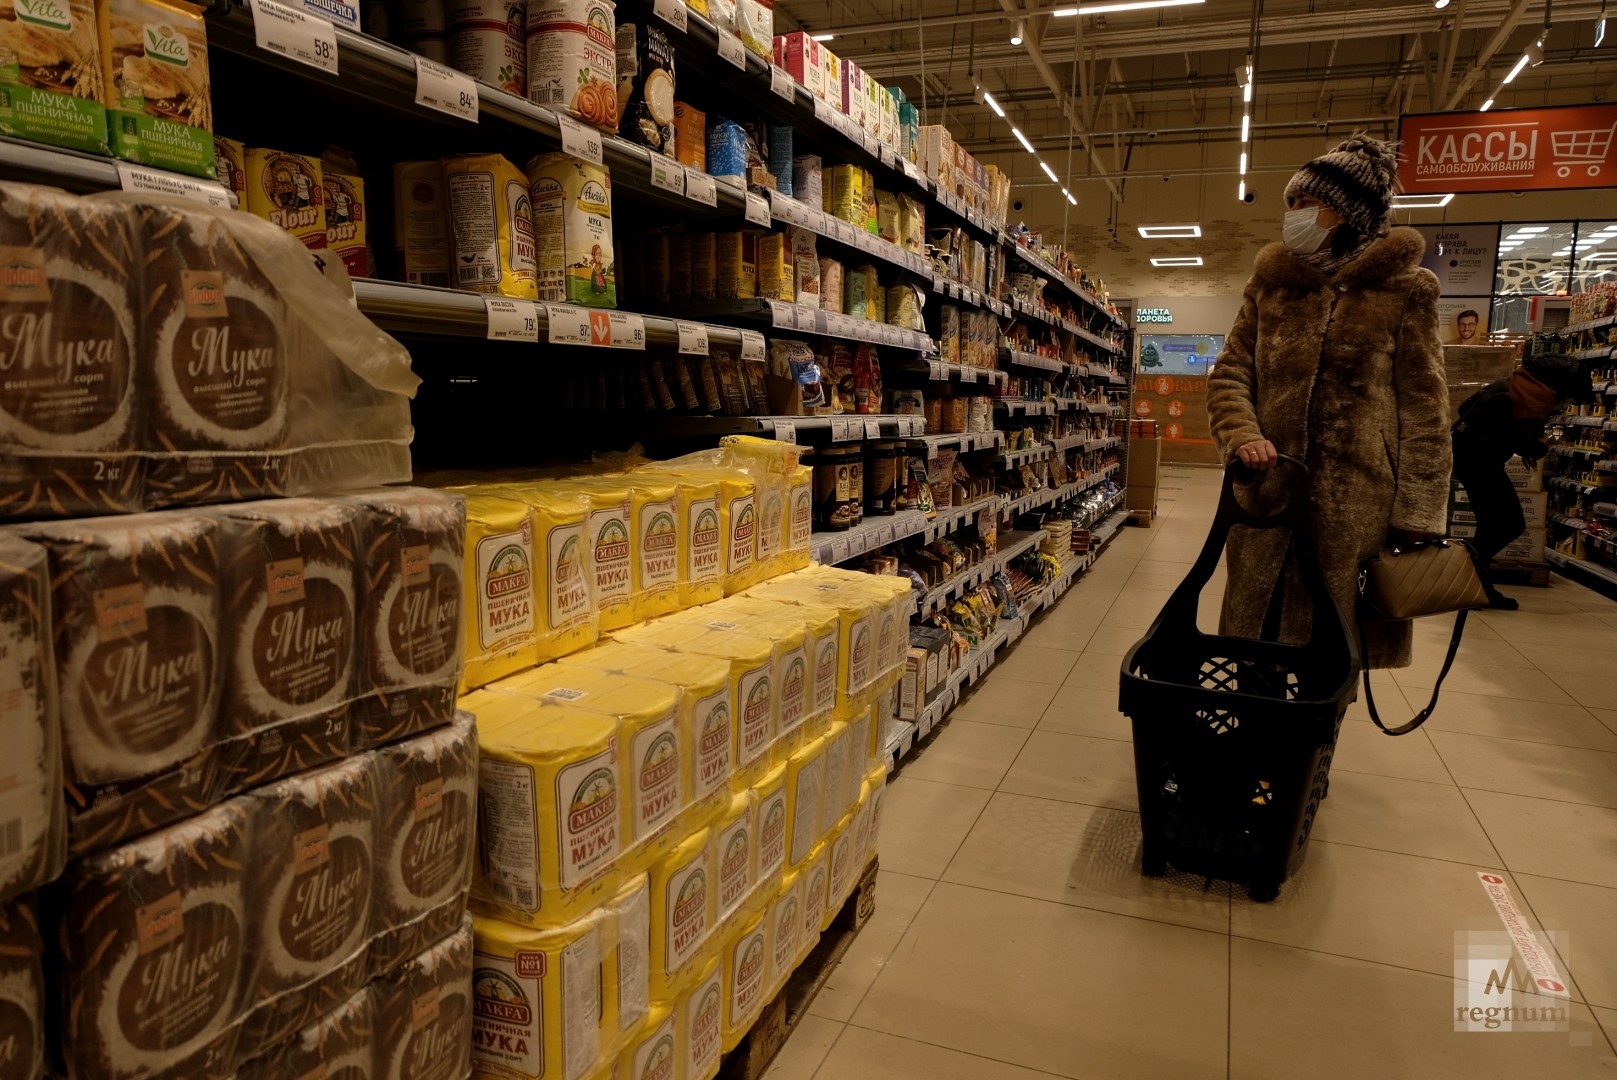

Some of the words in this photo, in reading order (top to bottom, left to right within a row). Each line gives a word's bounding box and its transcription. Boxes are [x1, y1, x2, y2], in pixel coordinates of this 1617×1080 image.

[27, 0, 67, 20] Vita
[154, 38, 185, 56] Vita
[314, 38, 330, 59] 58
[583, 47, 615, 72] ЭКСТРА
[31, 90, 78, 111] МУКА
[460, 92, 472, 108] 84
[16, 101, 93, 125] ПШЕНИЧНАЯ
[59, 121, 95, 134] ПОМОЛА
[153, 119, 191, 139] МУКА
[141, 129, 203, 151] ПШЕНИЧНАЯ
[586, 140, 599, 154] 139
[1417, 129, 1538, 165] КАССЫ
[1416, 160, 1536, 175] САМООБСЛУЖИВАНИЯ
[131, 171, 150, 182] МУКА
[151, 175, 180, 188] ГЛОБУС
[182, 182, 202, 193] ВИТА
[270, 207, 318, 231] Flour
[589, 217, 603, 227] МУКА
[1434, 240, 1468, 248] ОПРАВА
[1462, 247, 1487, 256] ЛИЦУ?
[524, 318, 535, 331] 79
[579, 324, 589, 337] 87
[633, 329, 642, 341] 96
[0, 312, 114, 382] Мука
[188, 326, 273, 388] Мука
[73, 372, 104, 385] сорт
[193, 381, 232, 394] высший
[94, 461, 104, 480] 2
[108, 466, 121, 480] кг
[599, 546, 628, 560] MAKFA
[694, 555, 718, 568] МУКА
[596, 561, 630, 573] ПШЕНИЧНАЯ
[647, 559, 677, 574] МУКА
[492, 573, 528, 594] MAKFA
[597, 569, 629, 586] МУКА
[488, 591, 530, 611] ПШЕНИЧНАЯ
[558, 586, 587, 609] МУКА
[399, 588, 456, 638] Мука
[490, 602, 530, 627] МУКА
[266, 607, 344, 664] Мука
[495, 622, 516, 633] ВЫСШИЙ
[100, 641, 198, 707] Мука
[325, 720, 333, 736] 2
[745, 724, 768, 748] МУКА
[704, 756, 729, 780] МУКА
[643, 789, 678, 820] МУКА
[572, 827, 616, 866] МУКА
[292, 867, 361, 927] Мука
[722, 874, 748, 905] МУКА
[674, 916, 705, 953] МУКА
[520, 960, 541, 970] №1
[473, 1018, 531, 1038] ШЕНИЧНАЯ
[693, 1026, 719, 1063] МУКА
[505, 1053, 522, 1062] СОРТ
